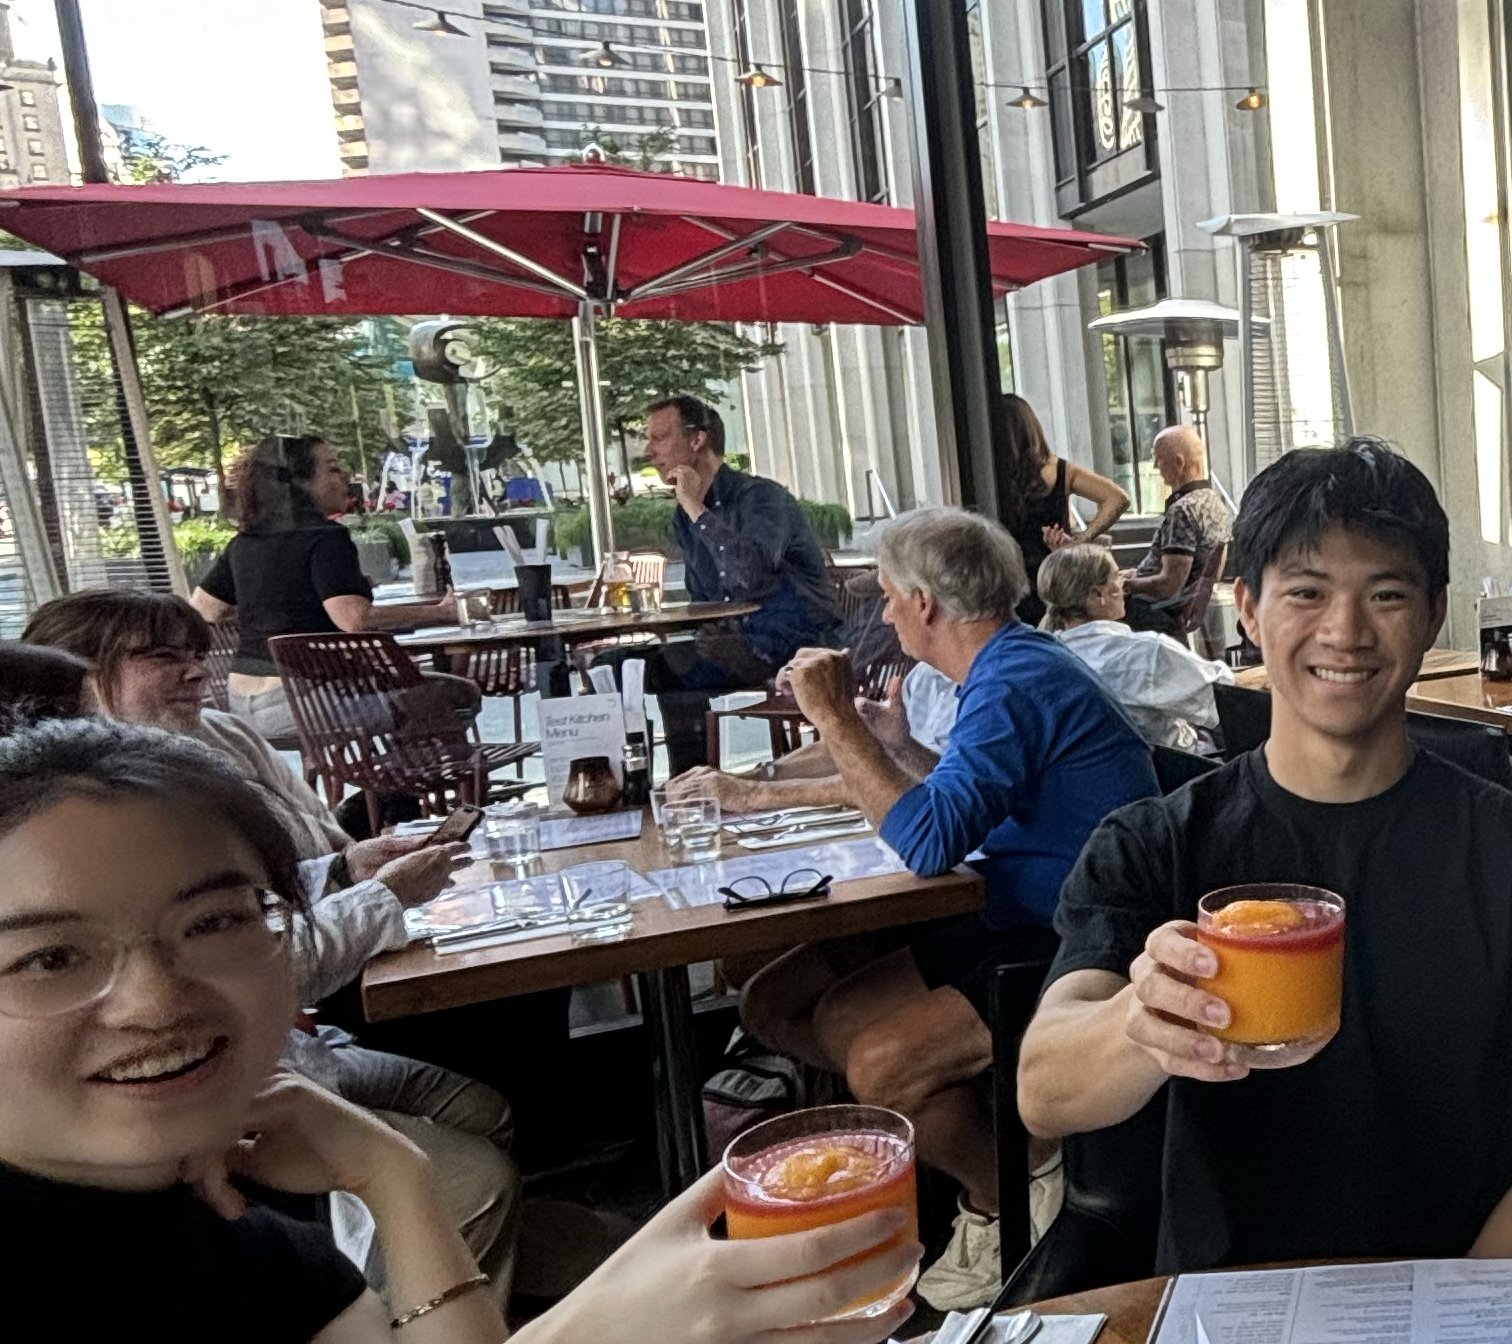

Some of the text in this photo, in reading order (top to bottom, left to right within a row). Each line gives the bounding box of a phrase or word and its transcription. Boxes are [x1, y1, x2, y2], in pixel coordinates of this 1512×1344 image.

[544, 713, 610, 727] Test Kitchen
[545, 728, 579, 738] Menu
